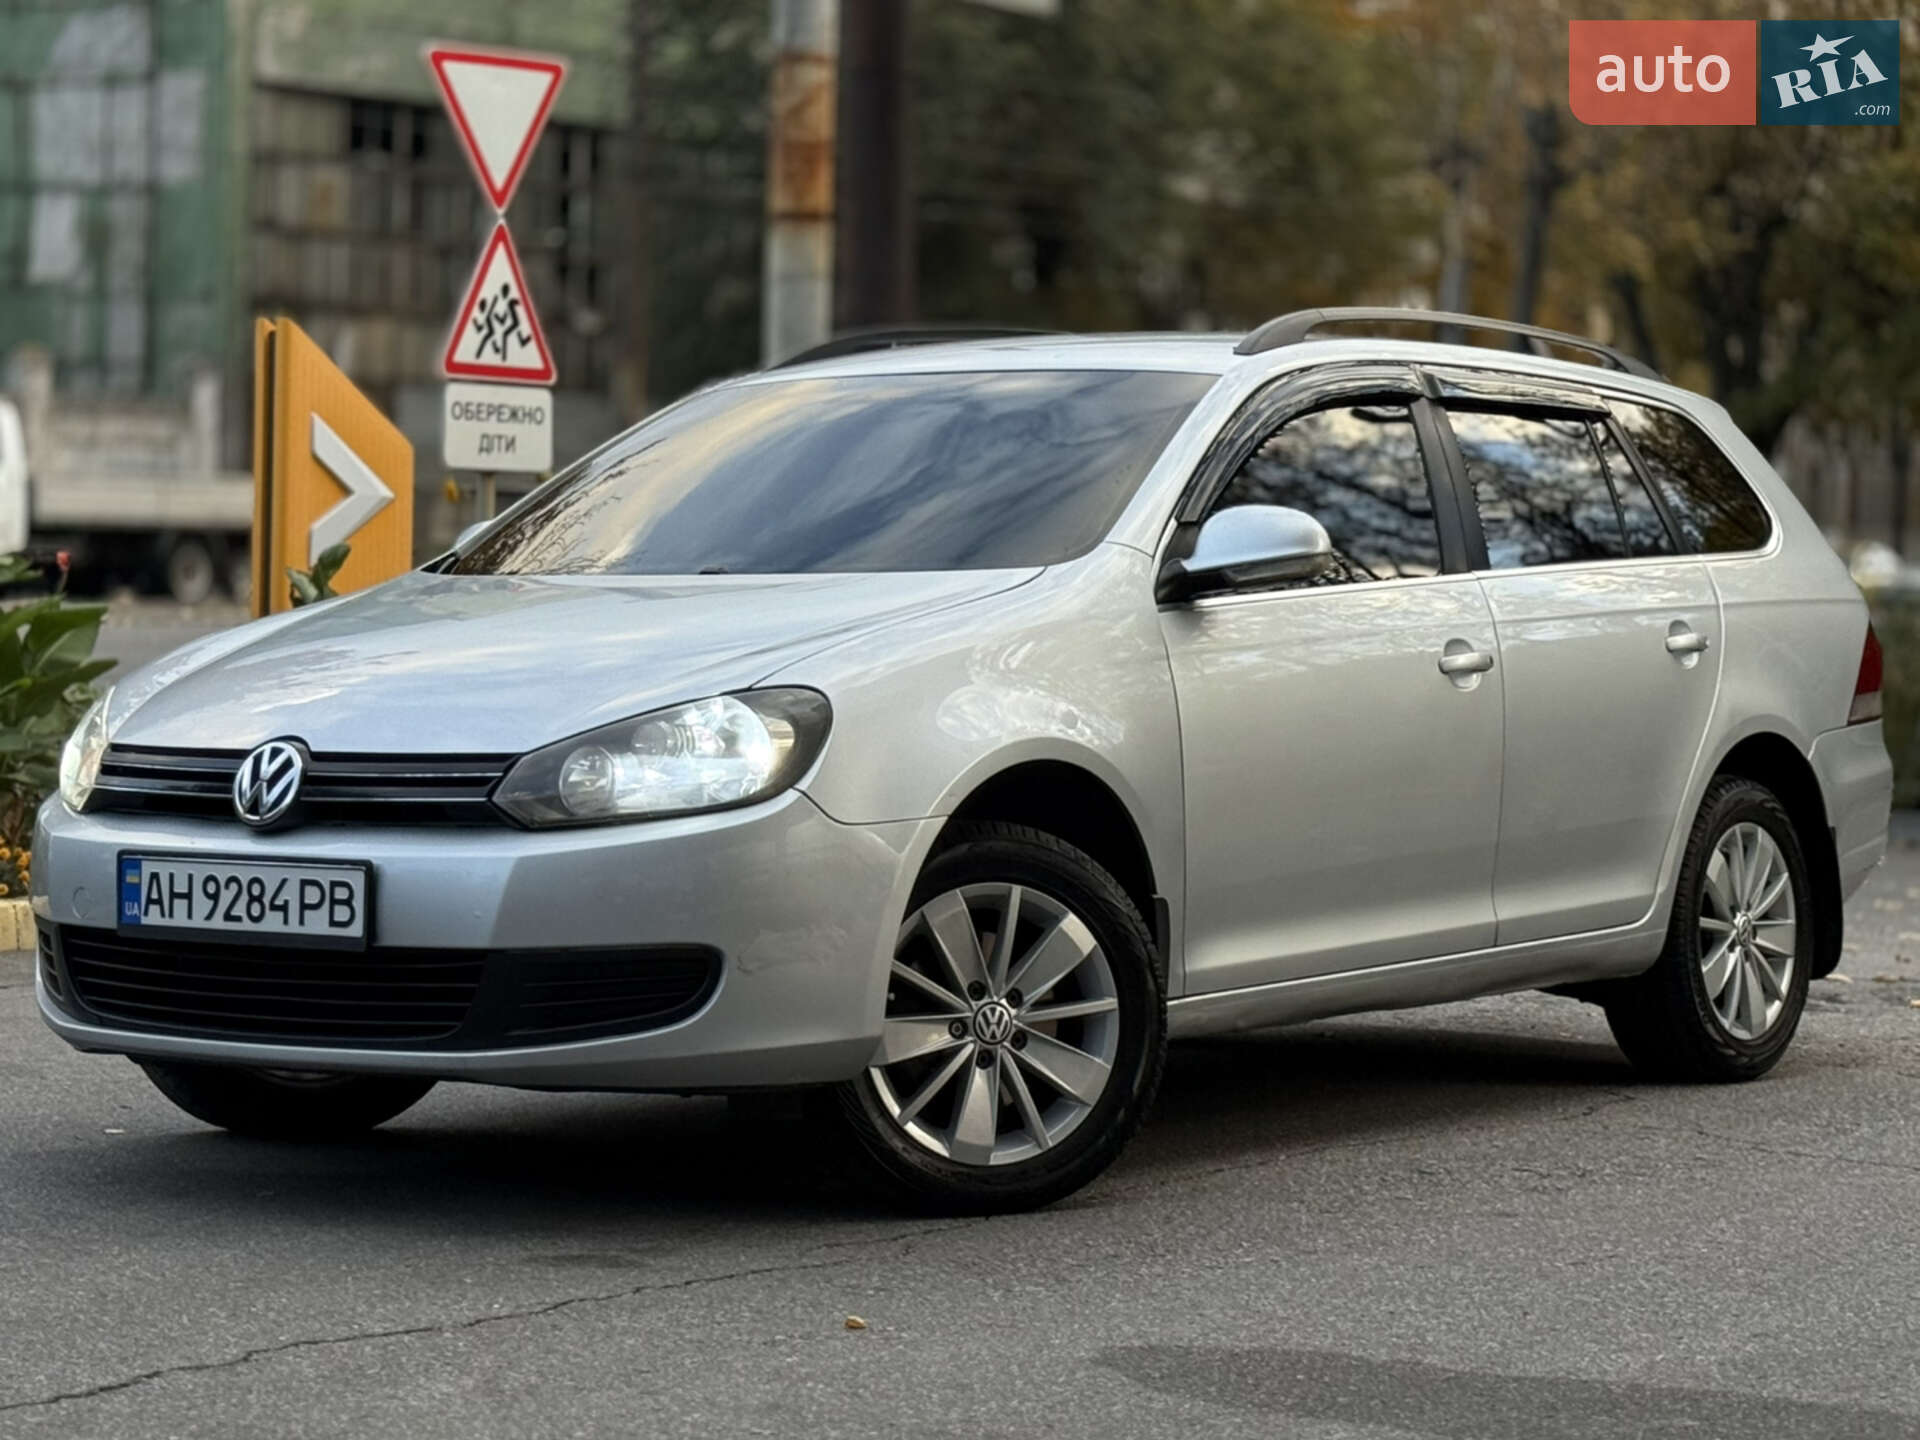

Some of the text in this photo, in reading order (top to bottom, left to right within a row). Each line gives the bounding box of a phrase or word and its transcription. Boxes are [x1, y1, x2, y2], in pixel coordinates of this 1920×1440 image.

[450, 401, 546, 426] ОБЕРЕЖНО
[478, 433, 517, 456] ДІТИ
[124, 901, 140, 917] UA
